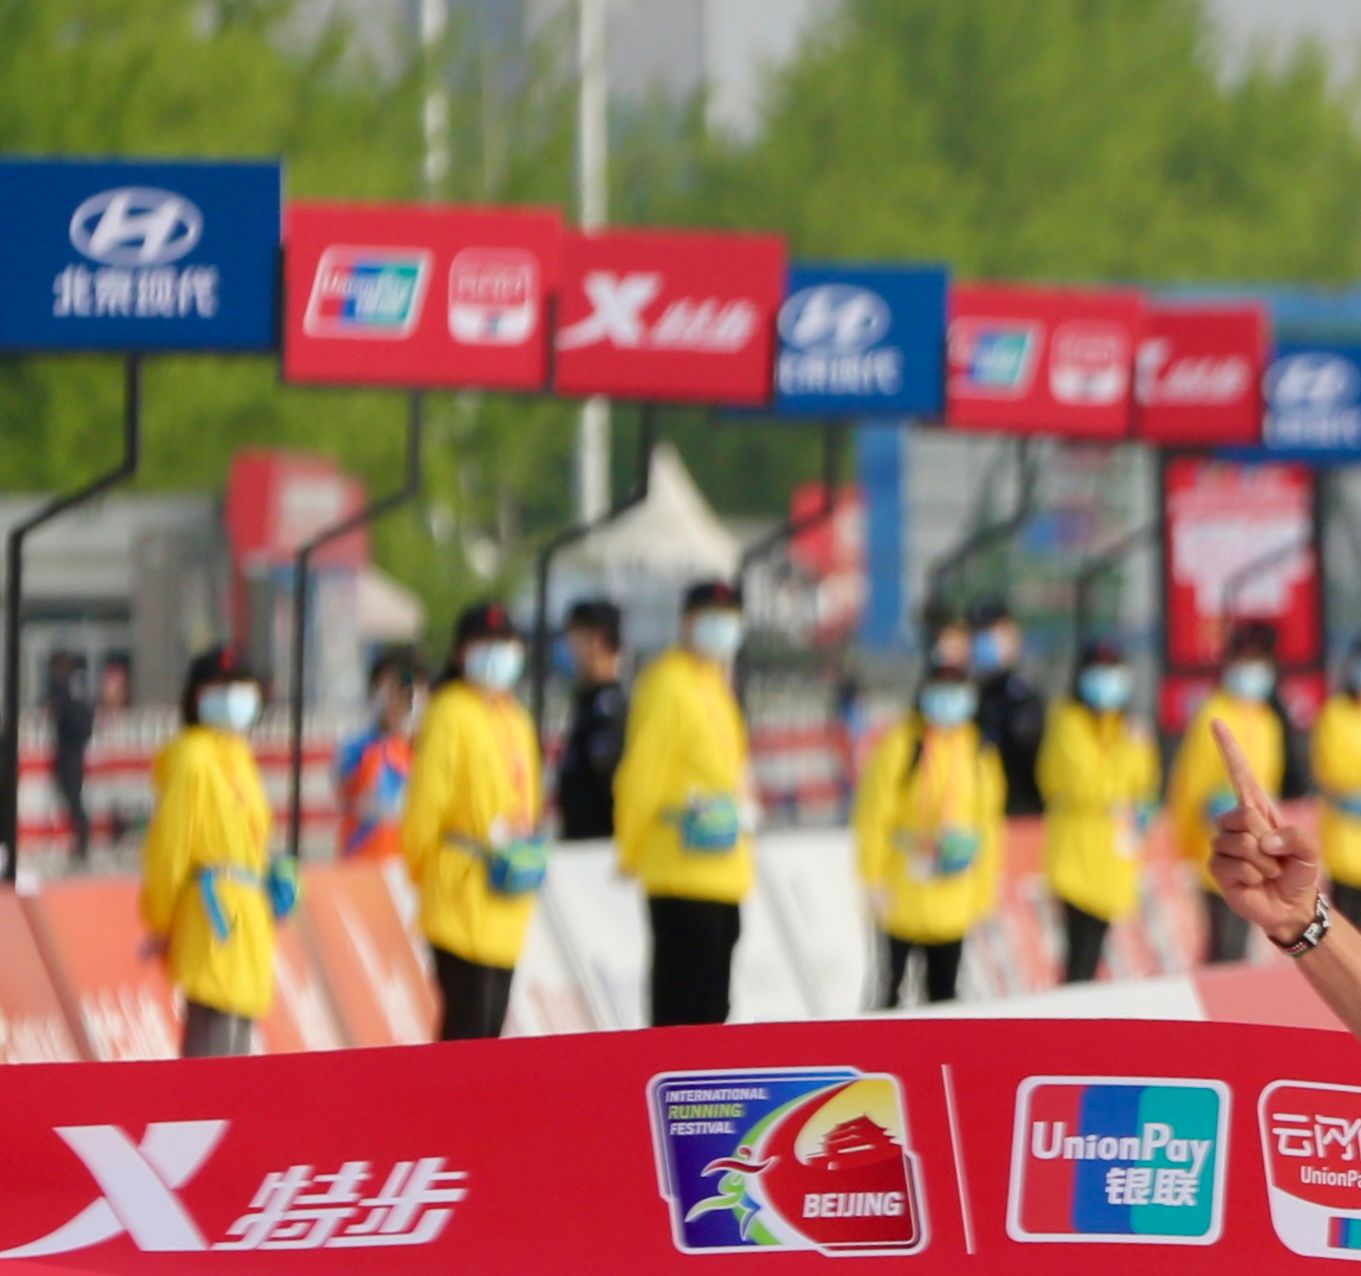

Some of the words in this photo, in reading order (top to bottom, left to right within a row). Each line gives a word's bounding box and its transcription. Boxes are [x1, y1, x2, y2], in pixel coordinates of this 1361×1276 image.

[664, 1087, 768, 1104] INTERNATIONAL
[667, 1103, 744, 1120] RUNNING
[669, 1121, 735, 1137] FESTIVAL
[1031, 1119, 1212, 1182] UnionPay
[1106, 1167, 1200, 1207] 银联
[210, 1156, 469, 1252] 特步
[802, 1192, 903, 1219] BEIJING
